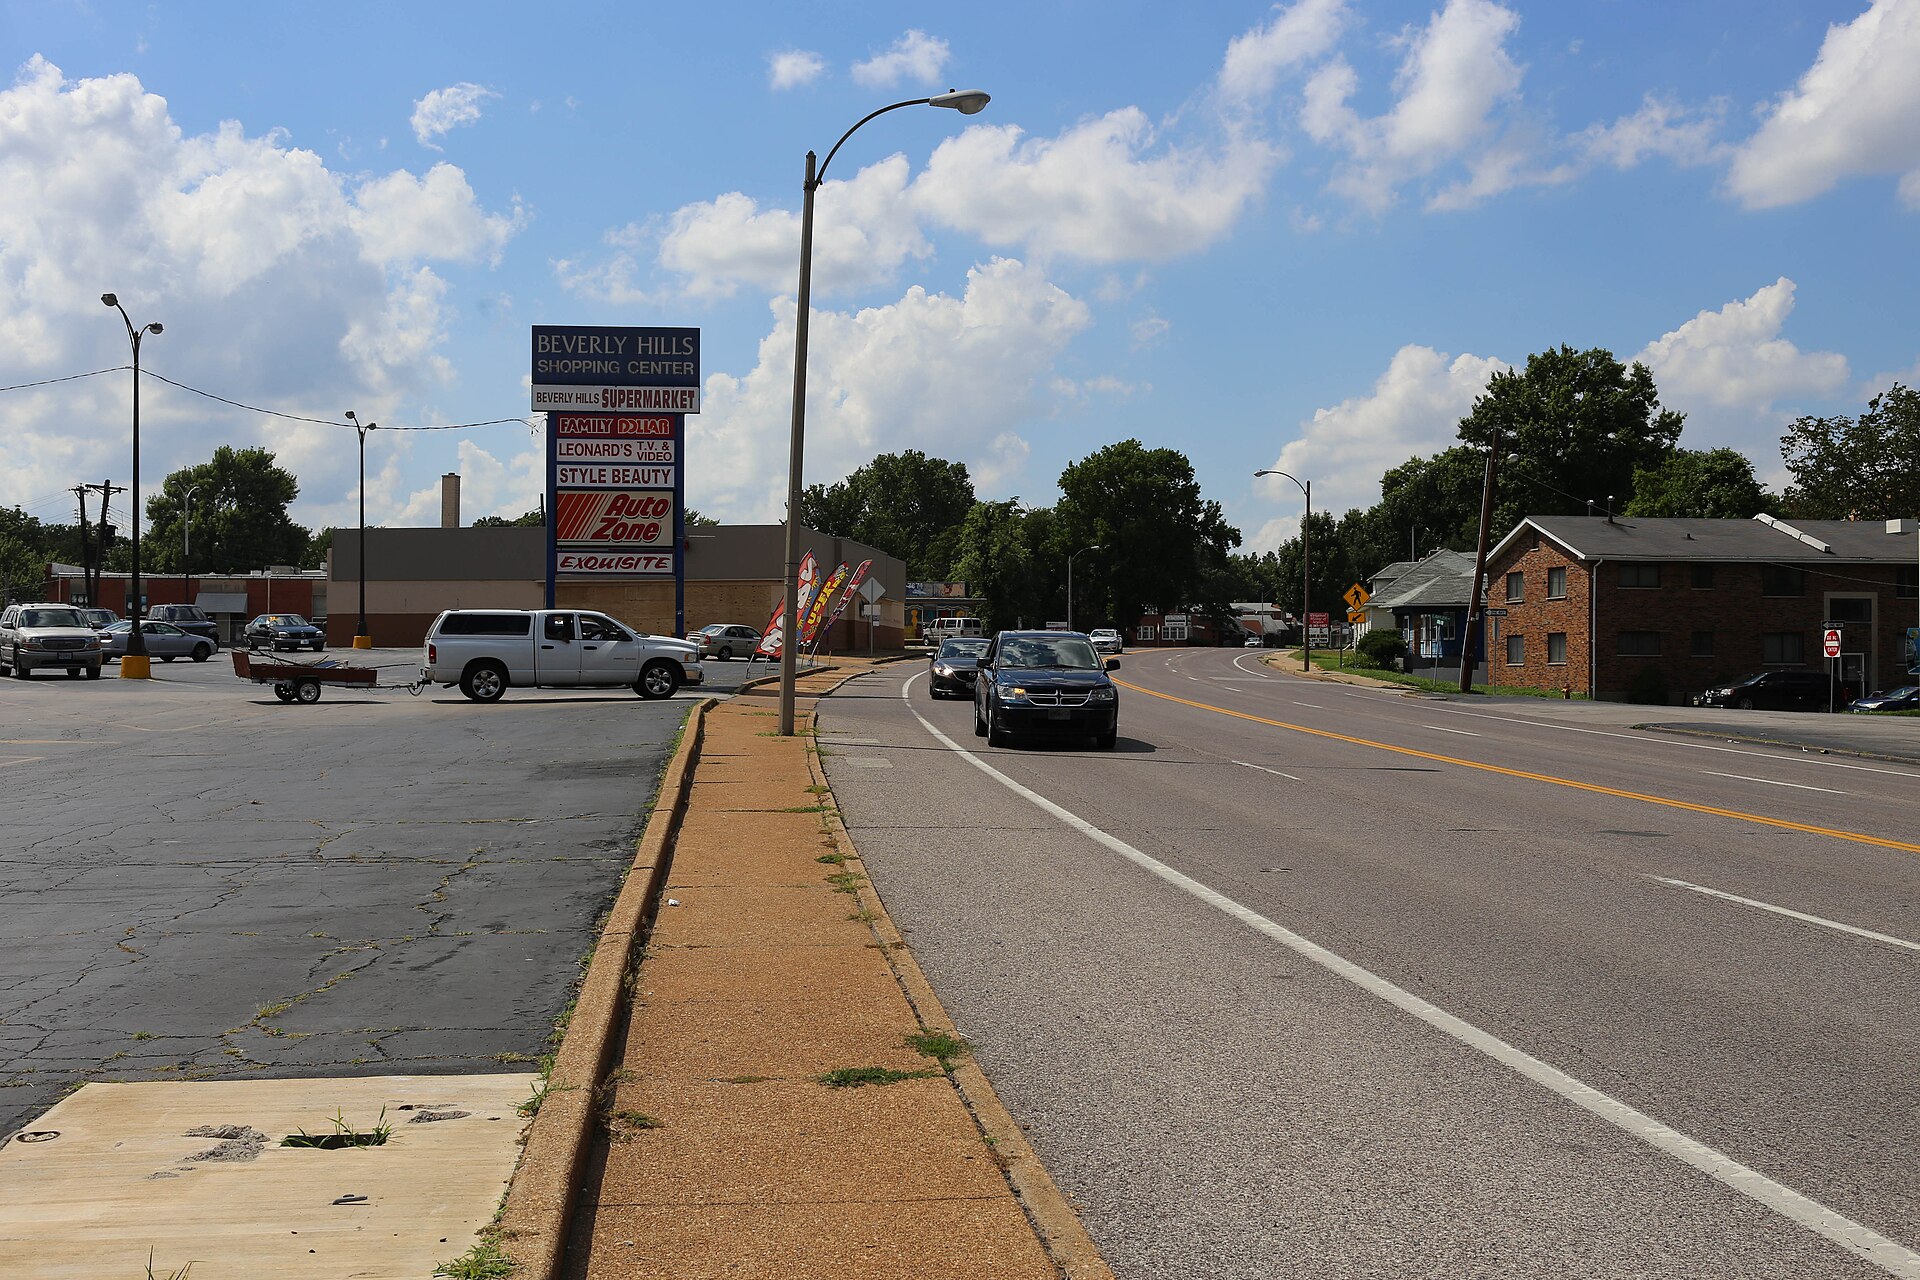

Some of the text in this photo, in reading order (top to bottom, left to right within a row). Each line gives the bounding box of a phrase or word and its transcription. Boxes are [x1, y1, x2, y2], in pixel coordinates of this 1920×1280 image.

[537, 335, 694, 355] BEVERLY HILLS
[537, 359, 694, 375] SHOPPING CENTER
[536, 388, 695, 409] BEVERLY HILLS SUPERMARKET
[559, 417, 670, 434] FAMILY DOLLAR
[559, 443, 632, 457] LEONARD'S
[637, 441, 670, 451] T.V. &
[637, 451, 672, 462] VIDEO
[559, 468, 671, 484] STYLE BEAUTY
[605, 493, 670, 518] Auto
[590, 517, 661, 542] Zone
[559, 556, 671, 570] EXQUISITE
